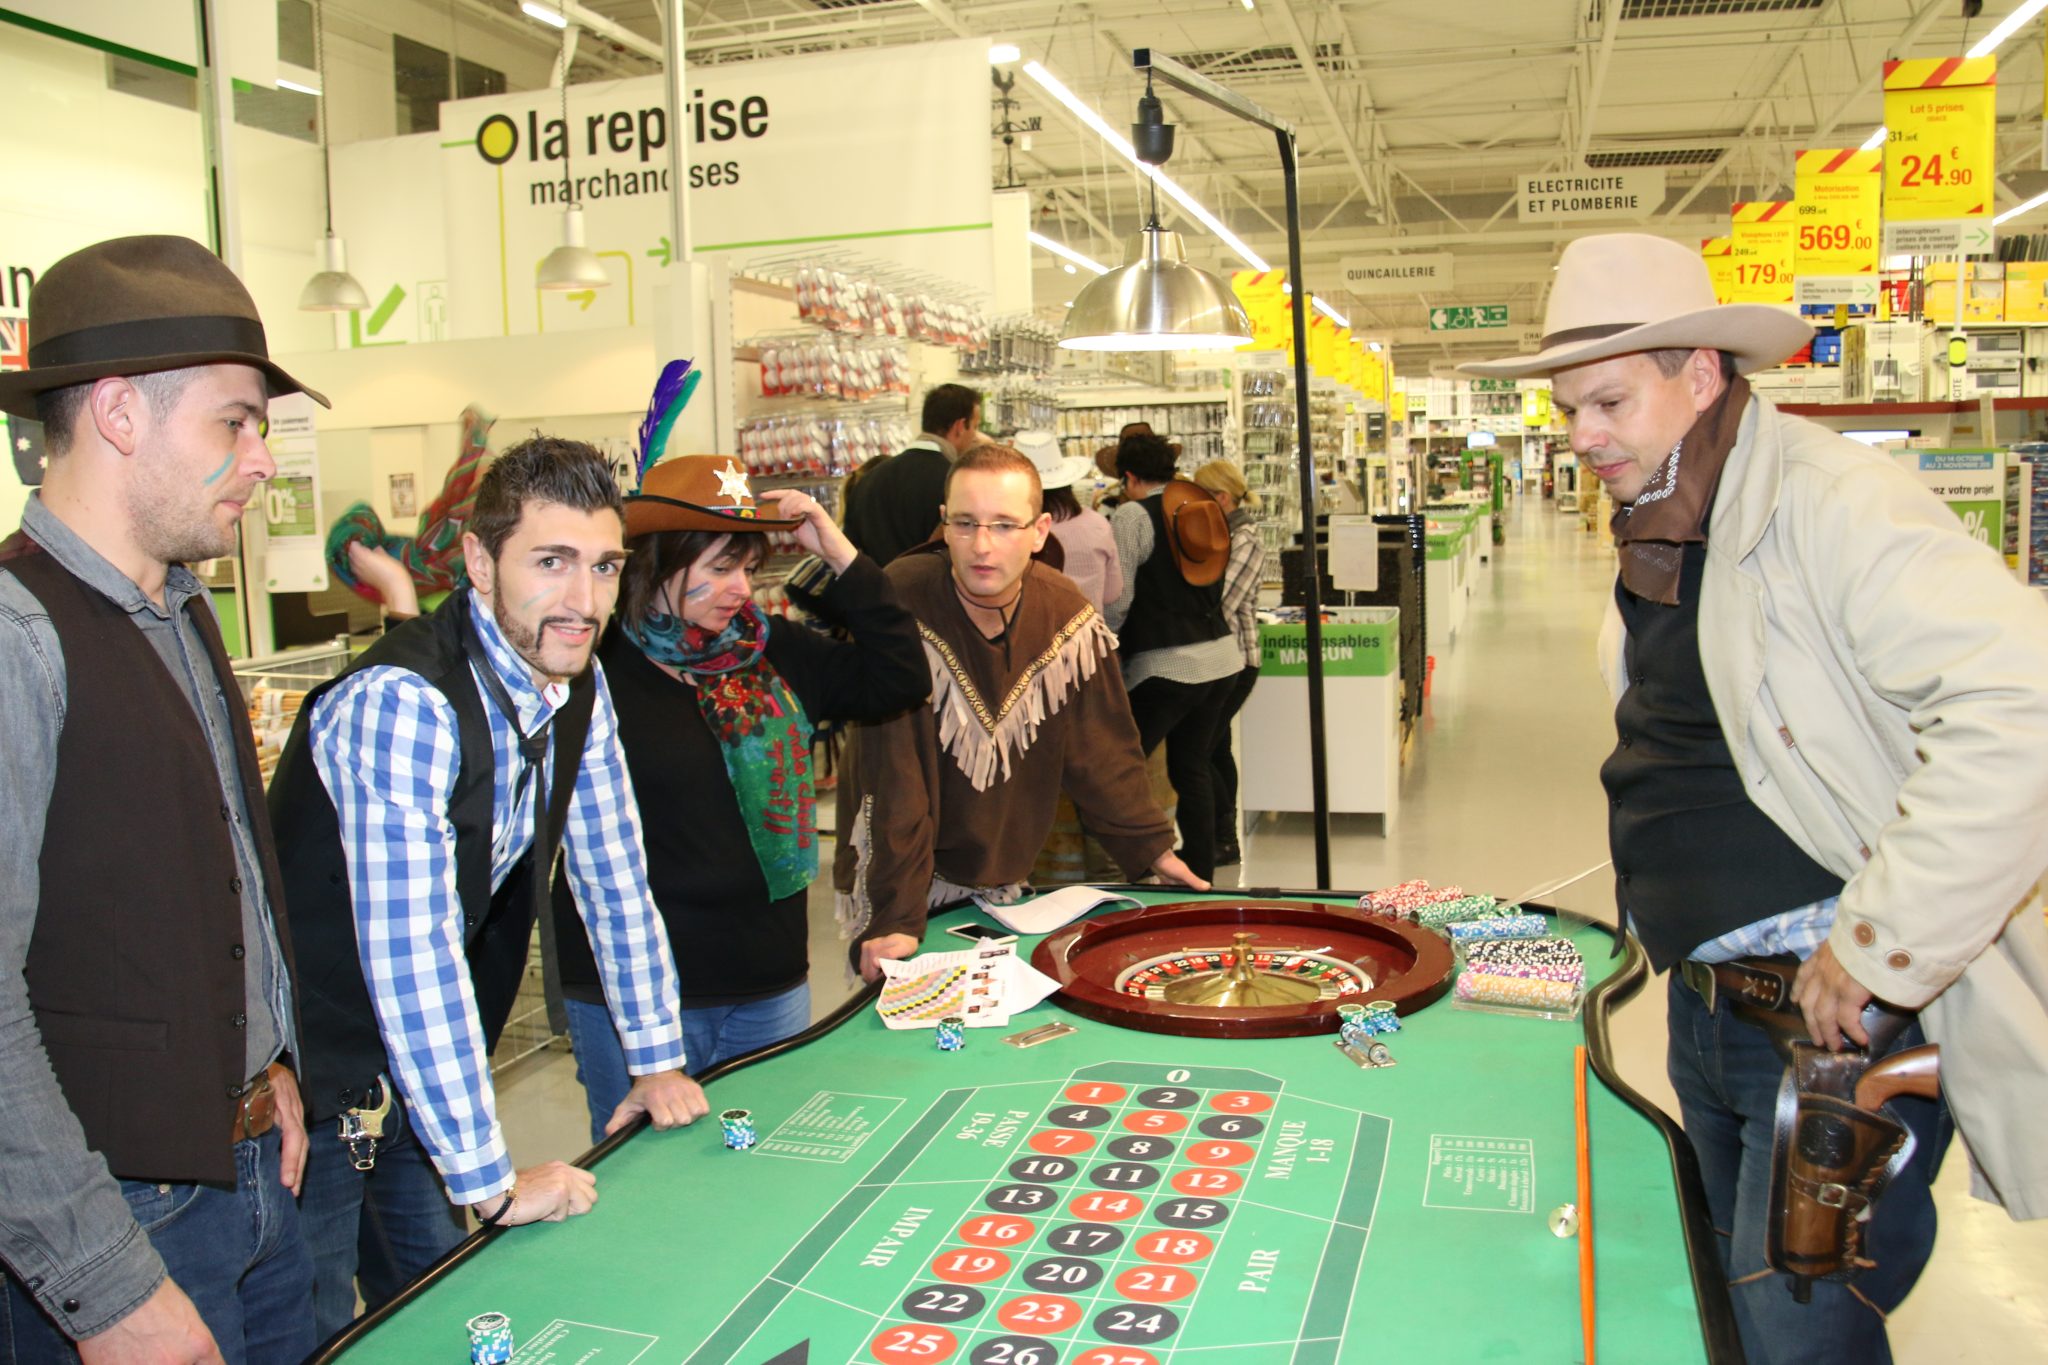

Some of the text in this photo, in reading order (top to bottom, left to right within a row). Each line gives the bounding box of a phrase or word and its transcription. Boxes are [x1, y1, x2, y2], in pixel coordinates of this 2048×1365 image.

[1910, 103, 1965, 114] Lot 5 prises
[527, 89, 769, 162] la repise
[530, 160, 740, 206] marchanses
[1528, 177, 1624, 194] ELECTRICITE
[1528, 196, 1638, 213] ET PLOMBERIE
[1347, 266, 1436, 280] QUINCAILLERIE
[1948, 485, 1972, 495] votre
[1974, 484, 1994, 497] projet
[1263, 634, 1380, 649] indispnsables
[1280, 644, 1353, 665] MASON
[1166, 1069, 1191, 1083] 0
[1087, 1087, 1102, 1098] 1
[1157, 1092, 1177, 1104] 2
[1230, 1096, 1250, 1108] 3
[1068, 1109, 1089, 1122] 4
[1144, 1115, 1167, 1127] 5
[955, 1111, 996, 1141] 19-36
[982, 1110, 1030, 1148] PASSE
[1220, 1119, 1243, 1133] 6
[1053, 1135, 1074, 1148] 7
[1129, 1141, 1152, 1155] 8
[1264, 1120, 1307, 1180] MANQUE
[1210, 1146, 1230, 1160] 9
[1306, 1138, 1335, 1163] 1-18
[1021, 1160, 1065, 1176] 10
[1103, 1167, 1144, 1183] 11
[1185, 1173, 1228, 1189] 12
[998, 1189, 1044, 1205] 13
[1082, 1196, 1130, 1213] 14
[1168, 1203, 1217, 1220] 15
[860, 1206, 934, 1267] IMPAIR
[971, 1221, 1023, 1239] 16
[1060, 1229, 1112, 1248] 17
[1149, 1237, 1199, 1256] 18
[945, 1253, 996, 1273] 19
[1237, 1249, 1281, 1293] PAIR
[1035, 1263, 1088, 1284] 20
[1127, 1271, 1178, 1292] 21
[914, 1290, 969, 1313] 22
[1010, 1301, 1066, 1323] 23
[1107, 1311, 1163, 1334] 24
[883, 1331, 945, 1354] 25
[984, 1342, 1046, 1365] 26
